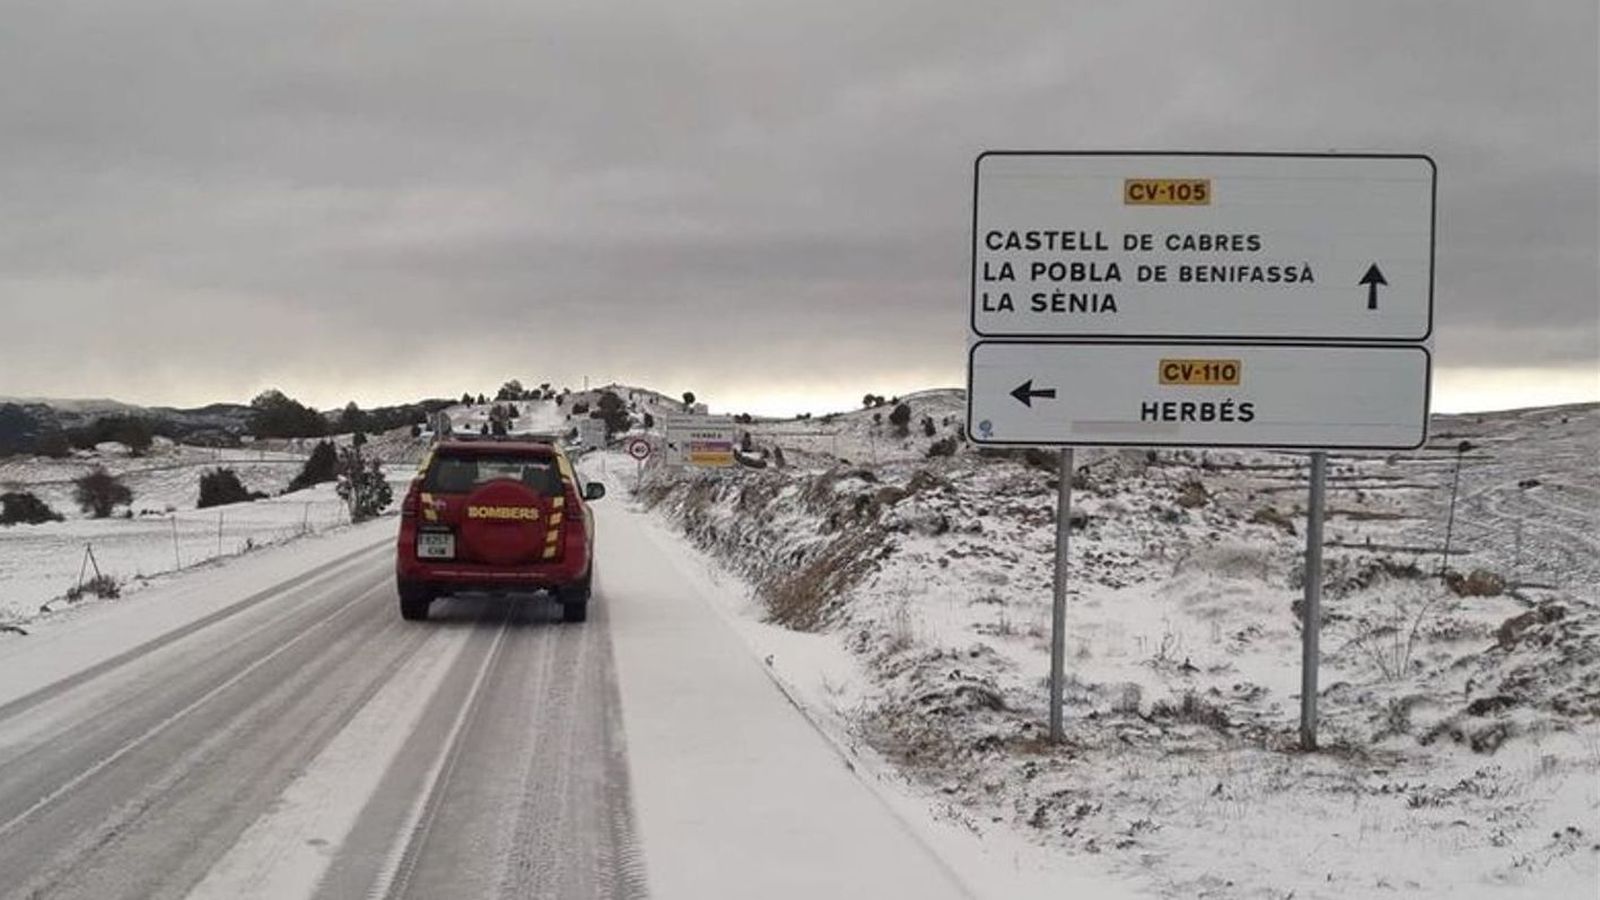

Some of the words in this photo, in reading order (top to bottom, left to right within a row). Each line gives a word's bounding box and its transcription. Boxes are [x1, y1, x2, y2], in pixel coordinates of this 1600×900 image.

[1129, 183, 1206, 201] CV-105
[985, 230, 1109, 251] CASTELL
[1123, 234, 1153, 251] DE
[1165, 234, 1262, 252] CABRES
[983, 261, 1016, 282] LA
[1031, 262, 1122, 282] POBLA
[1137, 265, 1168, 283] DE
[1179, 261, 1315, 284] BENIFASSÀ
[982, 292, 1015, 313] LA
[1031, 287, 1118, 313] SÈNIA
[1163, 362, 1237, 381] CV-110
[1140, 397, 1256, 423] HERBÉS
[467, 505, 539, 520] BOMBERS
